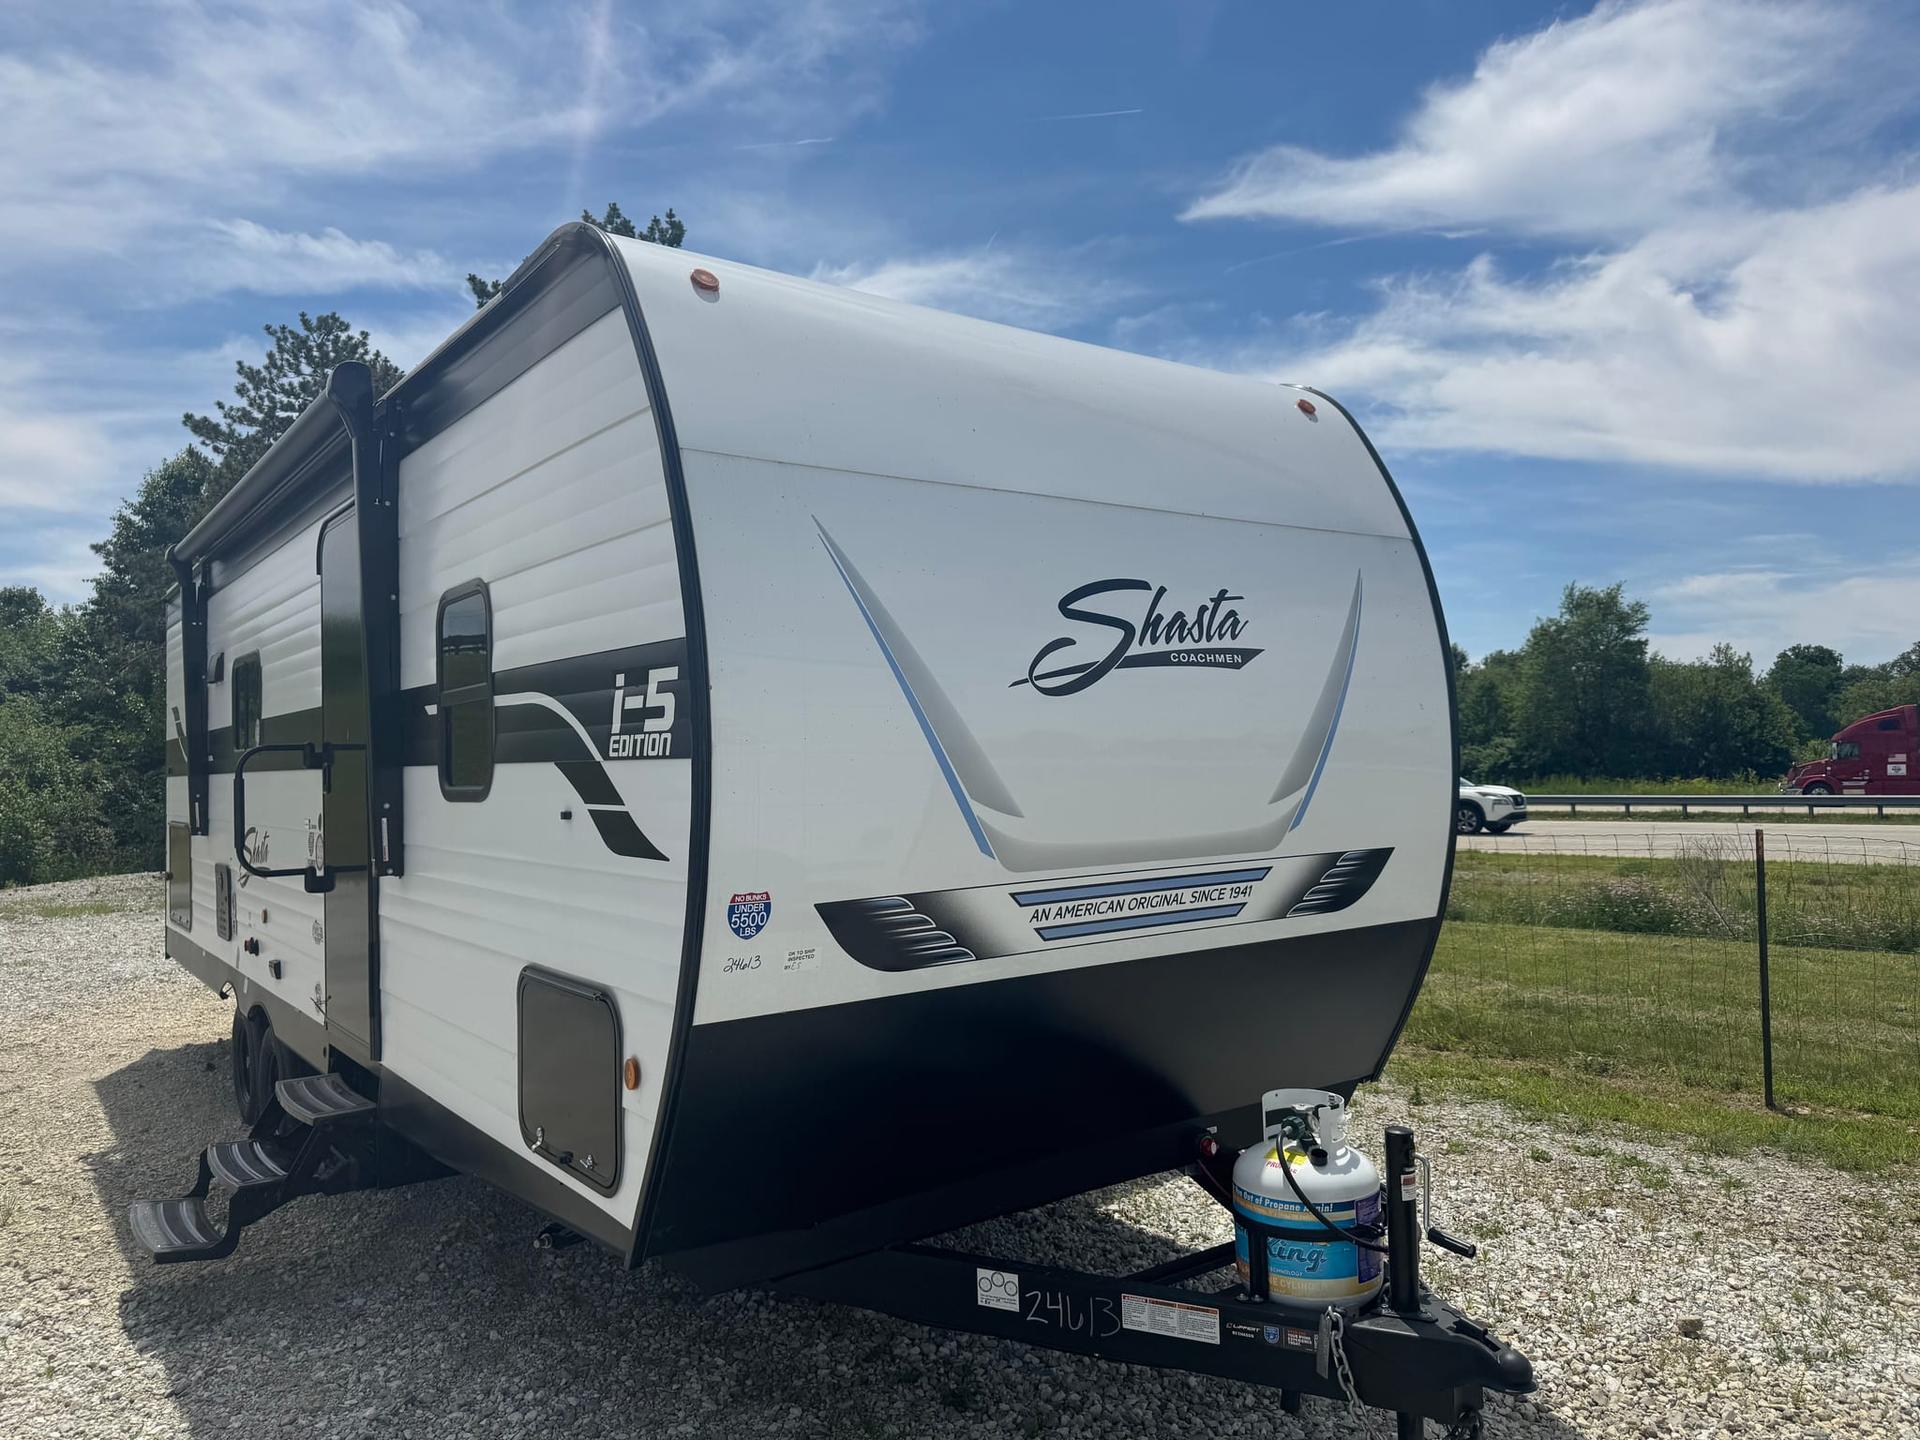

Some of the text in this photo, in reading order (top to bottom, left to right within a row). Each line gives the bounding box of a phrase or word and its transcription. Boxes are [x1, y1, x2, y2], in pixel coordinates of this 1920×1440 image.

[1028, 578, 1249, 697] Shasta
[1170, 652, 1242, 664] COACHMEN
[611, 666, 679, 734] i-5
[608, 732, 672, 757] EDITION
[735, 894, 767, 903] NO BUNKS
[1030, 885, 1253, 922] AN AMERICAN ORIGINAL SINCE 1941
[734, 903, 765, 913] UNDER
[731, 911, 767, 928] 5500
[739, 927, 757, 937] LBS
[723, 955, 761, 973] 24613
[1255, 1196, 1263, 1205] of
[1264, 1199, 1301, 1212] Propane
